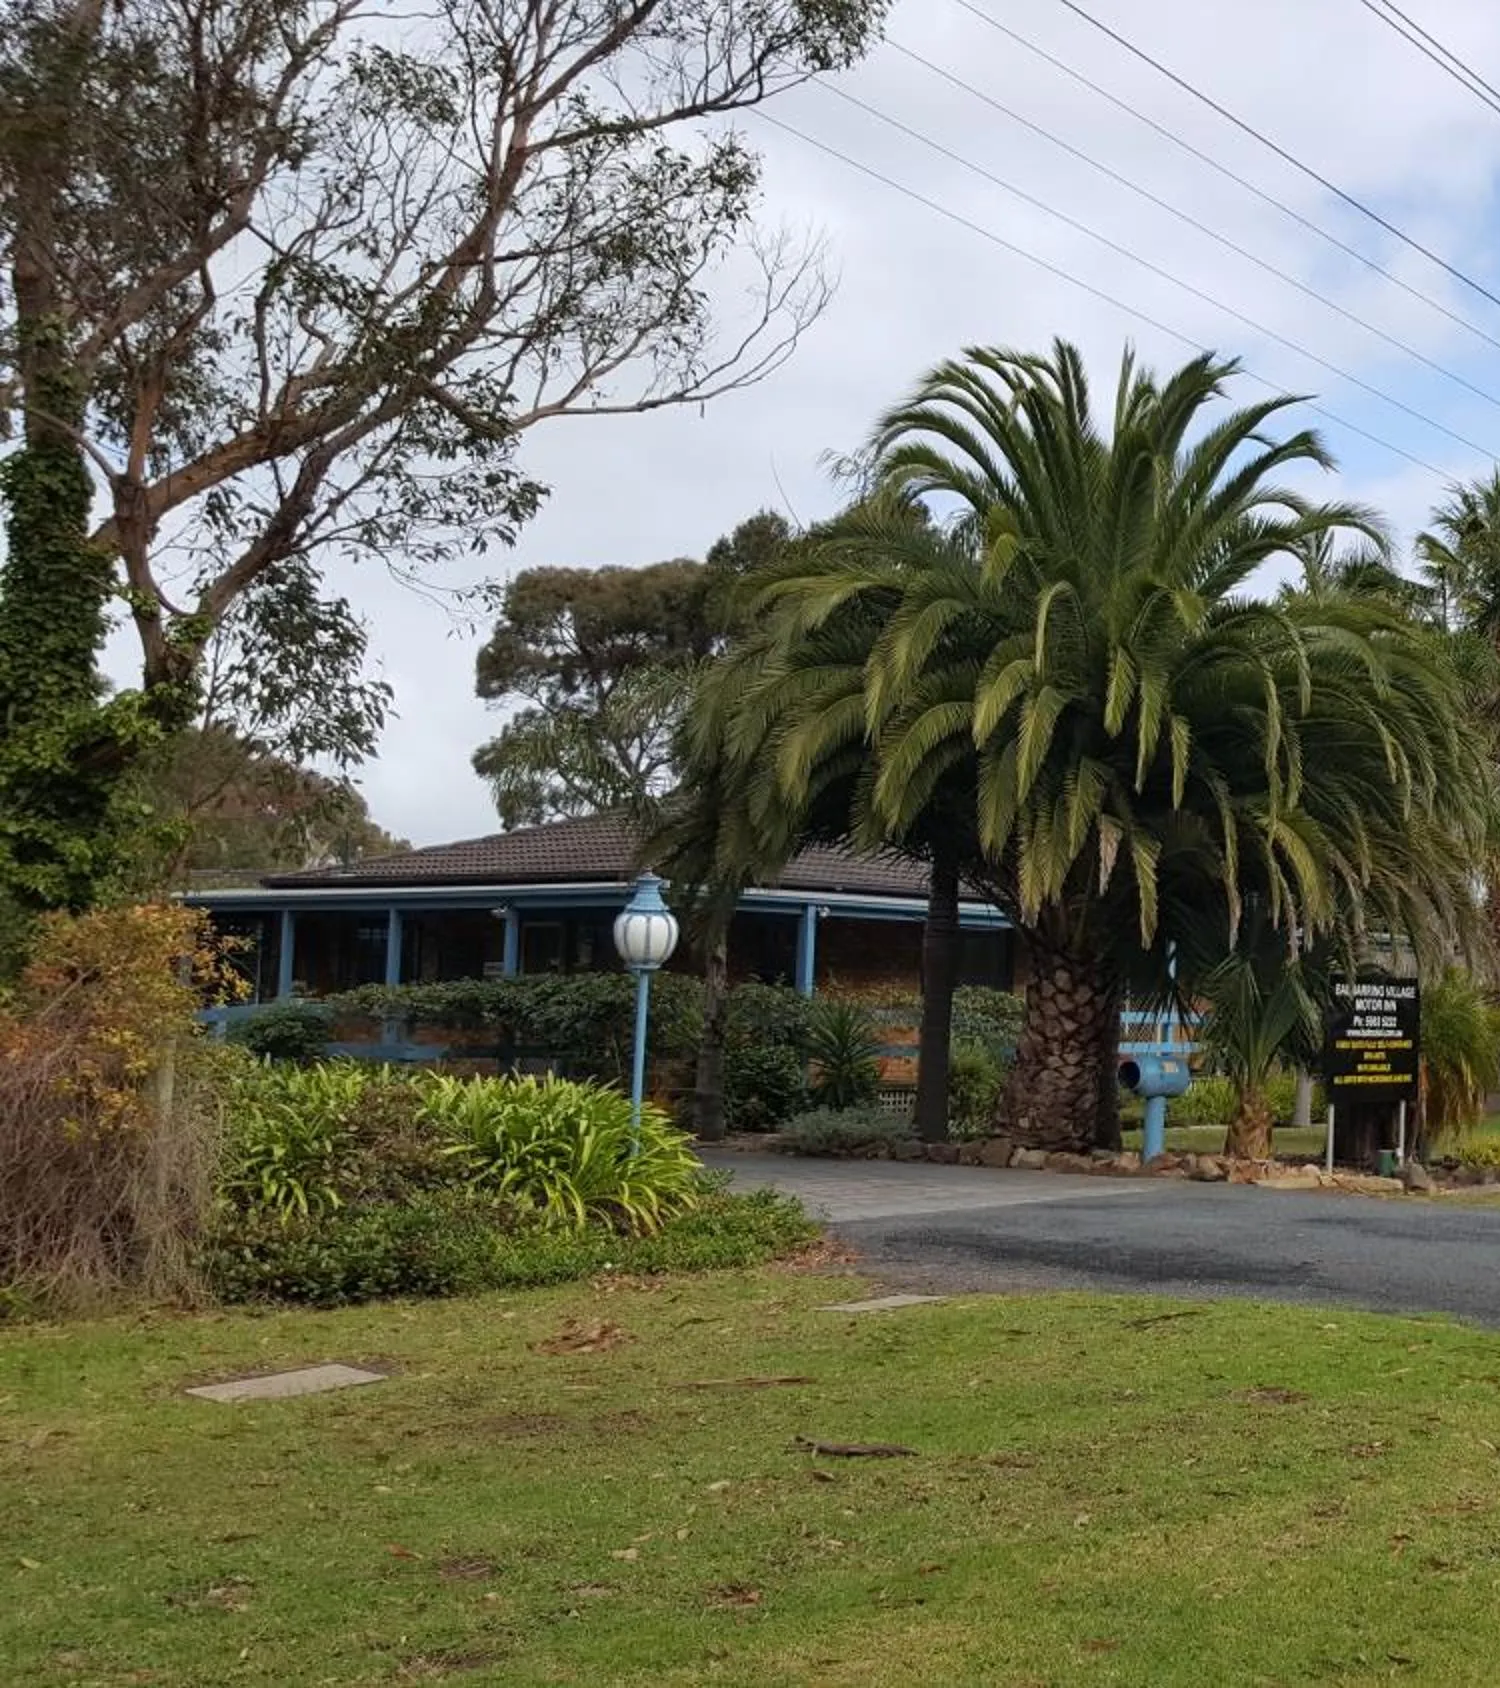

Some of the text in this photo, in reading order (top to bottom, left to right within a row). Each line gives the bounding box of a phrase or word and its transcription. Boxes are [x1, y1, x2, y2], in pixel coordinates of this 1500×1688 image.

[1386, 985, 1416, 999] VILLAGE
[1355, 999, 1397, 1012] MOTOR INN
